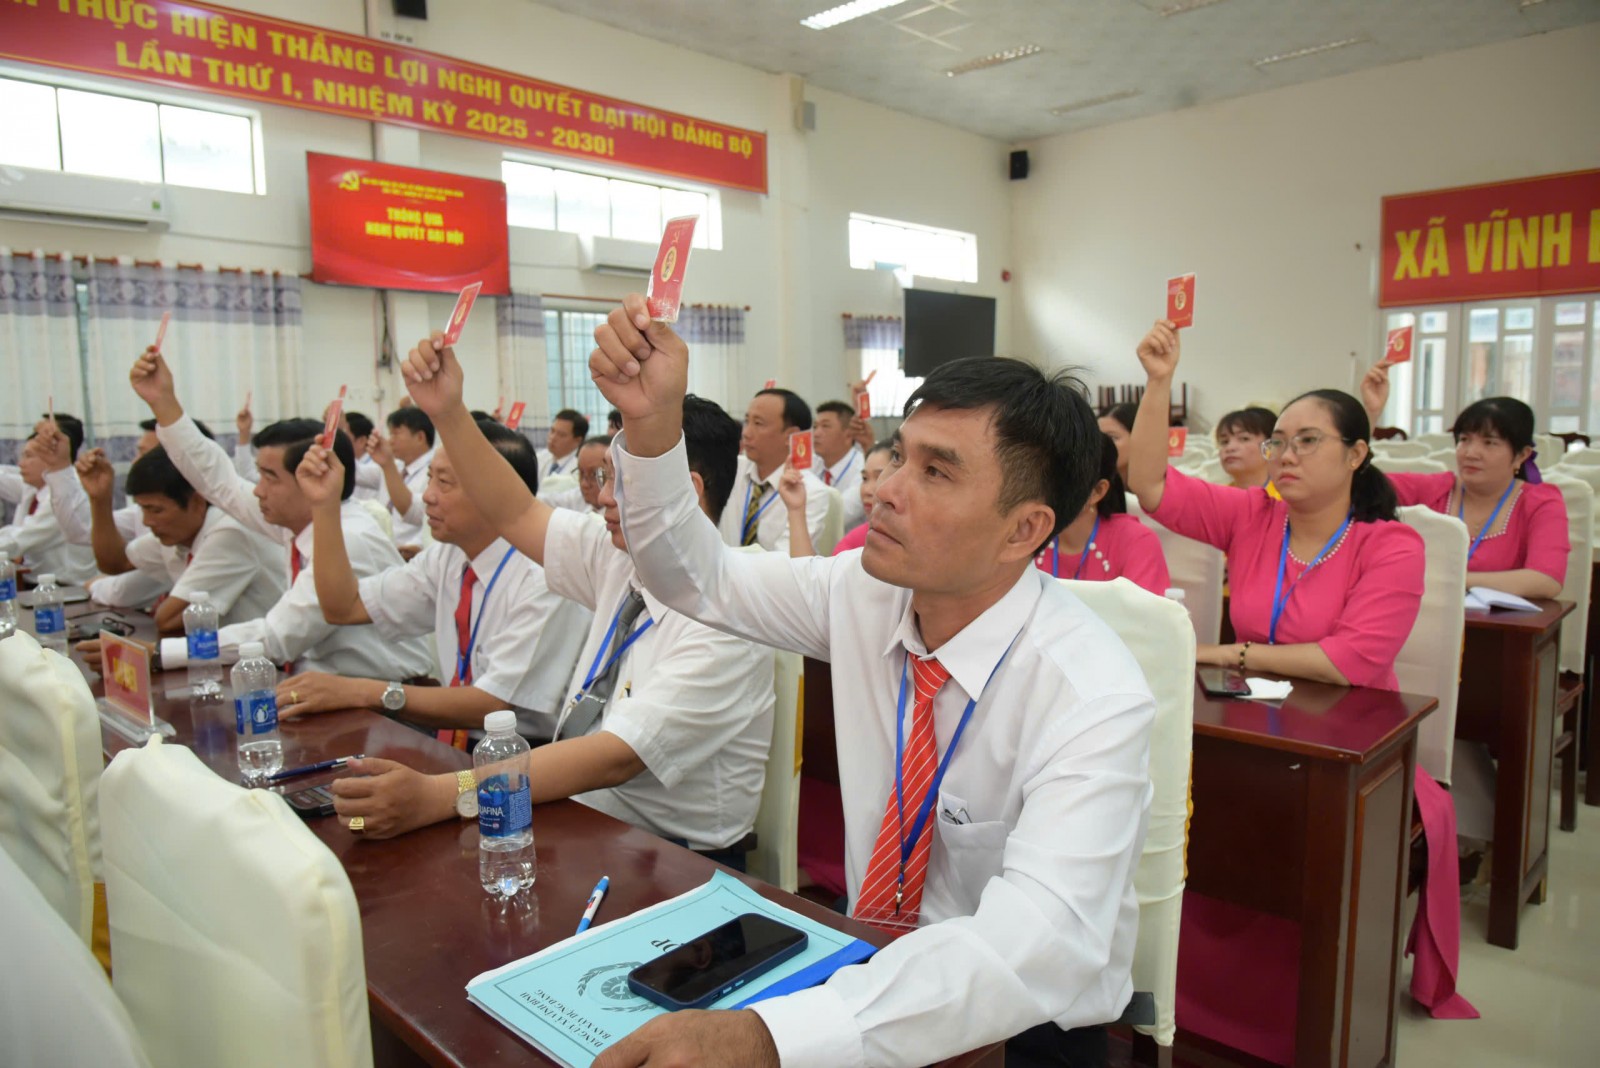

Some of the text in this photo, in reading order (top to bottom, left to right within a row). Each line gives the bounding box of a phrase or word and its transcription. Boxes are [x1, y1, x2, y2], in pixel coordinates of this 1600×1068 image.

[116, 39, 192, 78] LẦN
[203, 56, 273, 91] THỨ
[313, 79, 414, 118] NHIỆM
[422, 98, 458, 126] KỲ
[466, 109, 527, 140] 2025
[552, 126, 615, 156] 2030!
[171, 10, 257, 51] HIỆN
[267, 31, 374, 74] THẮNG
[384, 55, 429, 86] LỢI
[438, 67, 501, 106] NGHỊ
[510, 85, 582, 119] QUYẾT
[589, 103, 626, 130] ĐẠI
[632, 110, 666, 139] HỘI
[672, 120, 724, 150] ĐẢNG
[729, 136, 752, 160] BỘ
[1393, 216, 1450, 281] XÃ
[1464, 208, 1573, 274] VĨNH
